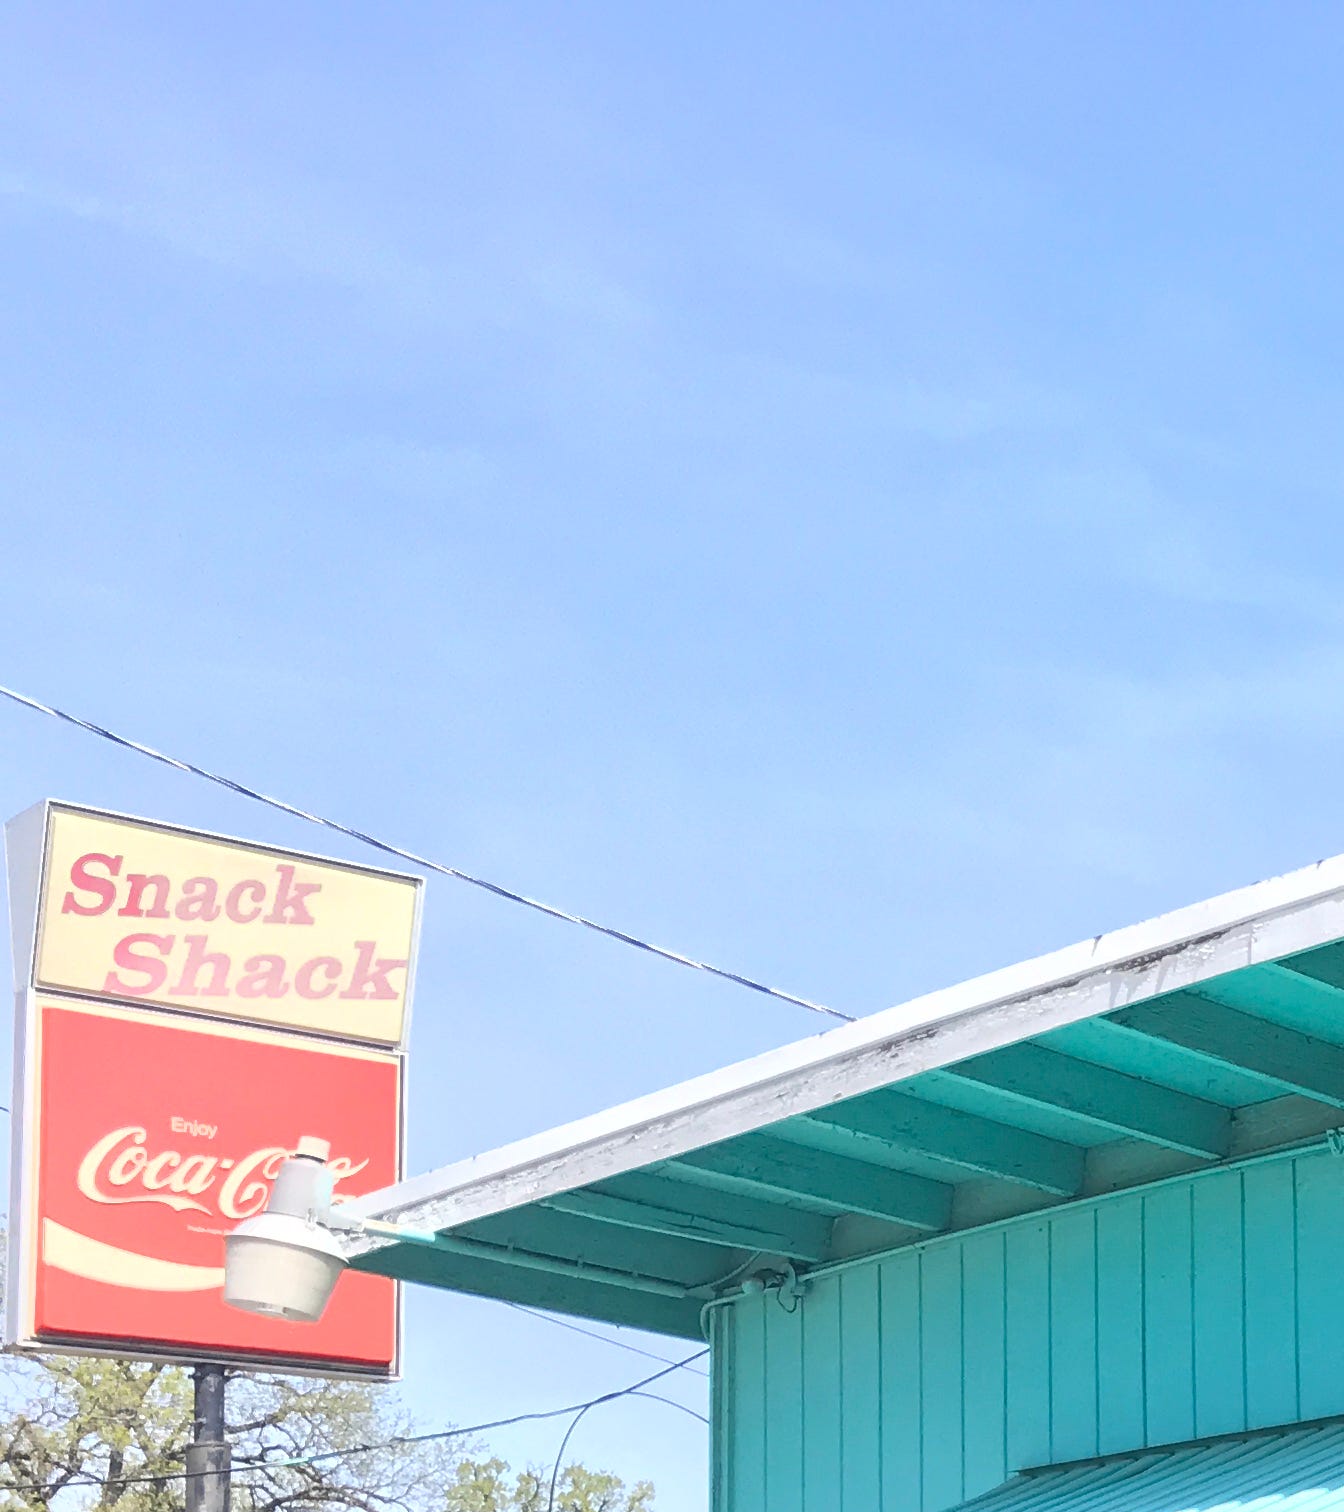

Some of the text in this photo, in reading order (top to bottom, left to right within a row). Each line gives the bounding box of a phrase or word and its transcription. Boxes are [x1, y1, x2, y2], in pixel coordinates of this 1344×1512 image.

[61, 851, 323, 926] Snack
[101, 931, 409, 1001] Shack
[171, 1116, 218, 1140] Enjoy
